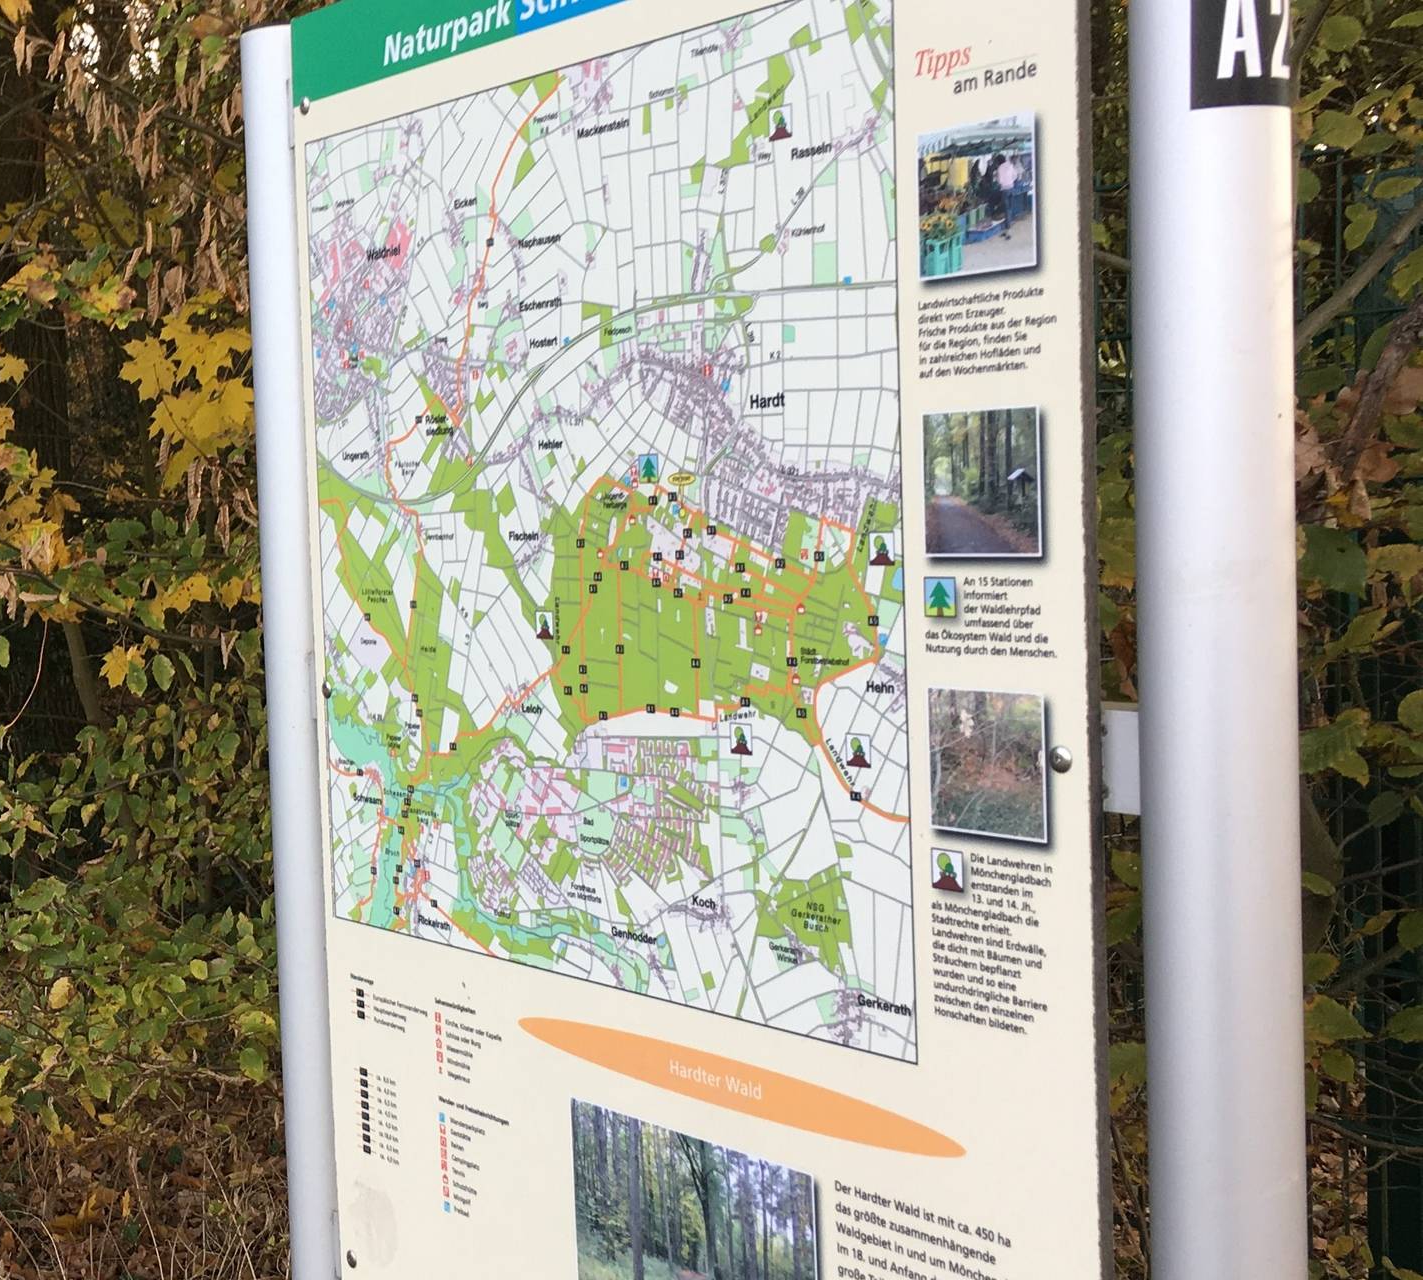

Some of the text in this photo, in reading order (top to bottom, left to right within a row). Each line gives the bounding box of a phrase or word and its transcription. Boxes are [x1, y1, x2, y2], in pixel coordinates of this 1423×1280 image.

[383, 1, 512, 66] Naturpark
[1217, 0, 1290, 79] A2
[915, 46, 972, 80] Tipps
[953, 60, 1037, 94] am Rande
[577, 118, 630, 139] Mackenstein
[791, 142, 833, 160] Rasseln
[366, 246, 401, 262] Waldniel
[918, 287, 1044, 310] Landwirtschaftliche Produkte
[918, 313, 943, 324] direkt
[945, 313, 963, 322] vom
[918, 314, 1057, 338] Frische Produkte aus der Region
[919, 330, 1027, 351] für die Region, finden Sie
[919, 343, 1041, 365] in zahlreichen Hofläden und
[919, 360, 1028, 379] auf den Wochenmärkten.
[749, 394, 785, 409] Hardt
[963, 576, 1033, 587] An 15 Stationen
[963, 590, 1008, 601] informiert
[964, 604, 1041, 616] der Waldlehrpfad
[964, 618, 1033, 629] umfassend über
[925, 629, 1048, 644] das Ökosystem Wald und die
[925, 643, 1057, 658] Nutzung durch den Menschen.
[866, 681, 895, 694] Hehn
[719, 711, 756, 723] Landwehr
[970, 853, 1053, 874] Die Landwehren in
[971, 867, 1051, 888] Mönchengladbach
[971, 881, 1033, 898] entstanden im
[692, 894, 716, 910] Koch
[972, 893, 984, 904] 13.
[986, 897, 1003, 908] und
[1006, 899, 1018, 910] 14.
[931, 900, 1039, 928] als Mönchengladbach die
[931, 913, 1012, 936] Stadtrechte erhielt.
[611, 926, 657, 945] Genhodder
[932, 927, 1046, 957] Landwehren sind Erdwälle,
[932, 940, 1042, 970] die dicht mit Bäumen und
[933, 952, 1022, 979] Sträuchern bepflanzt
[933, 968, 1016, 992] wurden und so eine
[857, 994, 912, 1016] Gerkerath
[933, 981, 1048, 1012] undurchdringliche Barriere
[934, 994, 1034, 1022] zwischen den einzelnen
[934, 1006, 1027, 1035] Honschaften bildeten.
[669, 1059, 762, 1100] Hardter Wald
[834, 1180, 1011, 1248] Der Hardter Wald ist mit ca. 450 ha
[835, 1202, 996, 1265] das größte zusammenhängende
[835, 1221, 891, 1250] Waldgebiet
[894, 1241, 904, 1254] in
[907, 1246, 926, 1263] und
[929, 1256, 946, 1270] um
[837, 1243, 849, 1257] Im
[852, 1247, 866, 1262] 18.
[868, 1255, 887, 1271] und
